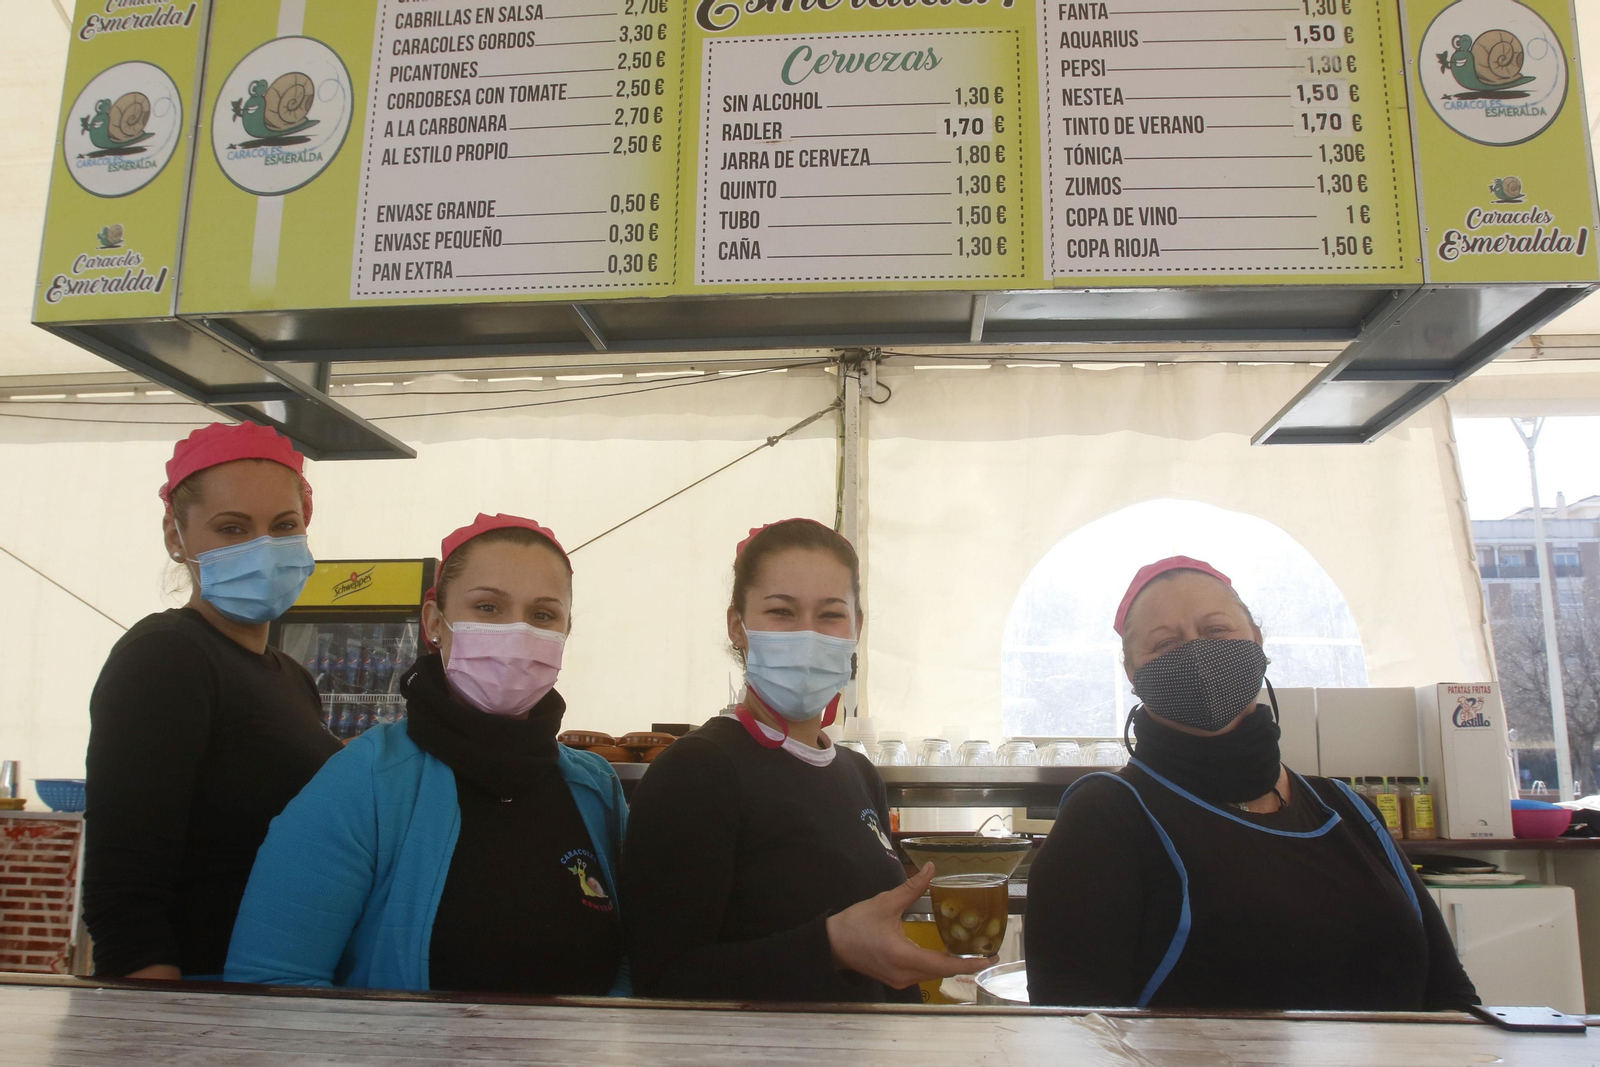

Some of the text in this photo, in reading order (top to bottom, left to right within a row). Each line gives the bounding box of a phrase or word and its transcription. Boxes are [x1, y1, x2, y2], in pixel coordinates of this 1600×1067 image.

[395, 9, 472, 29] CABRILLAS
[476, 7, 494, 24] EN
[498, 4, 543, 22] SALSA
[1059, 0, 1351, 20] FANTA 1,30 €
[393, 24, 667, 56] CARACOLES GORDOS 3,30 €
[1060, 25, 1354, 49] AQUARIUS 1,50 €
[390, 51, 665, 82] PICANTONES 2,50 €
[781, 45, 942, 85] Cervezas
[1061, 55, 1357, 77] PEPSI 1,30 €
[387, 78, 664, 110] CORDOBESA CON TOMATE 2,50 €
[723, 86, 1004, 112] SIN ALCOHOL 1,30 €
[1062, 84, 1359, 106] NESTEA 1,50 €
[1443, 99, 1501, 110] CARACOLES
[384, 106, 663, 137] A LA CARBONARA 2,70 €
[1485, 104, 1547, 117] ESMERALDA
[722, 115, 1004, 141] RADLER 1,70 €
[1063, 113, 1362, 135] TINTO DE VERANO 1,70 €
[76, 155, 123, 168] CARACOLES
[226, 147, 282, 160] CARACOLES
[264, 148, 323, 166] ESMERALDA
[382, 135, 662, 165] AL ESTILO PROPIO 2,50 €
[721, 145, 1005, 170] JARRA DE CERVEZA 1,80 €
[1064, 144, 1123, 165] TÓNICA
[107, 159, 157, 172] ESMERALDA
[720, 175, 1006, 200] QUINTO 1,30 €
[1065, 174, 1368, 196] ZUMOS 1,30 €
[377, 193, 659, 222] ENVASE GRANDE 0,50 €
[719, 205, 1006, 229] TUBO 1,50 €
[1066, 205, 1370, 227] COPA DE VINO 1 €
[1466, 206, 1553, 230] Caracoles
[375, 223, 658, 252] ENVASE PEQUEÑO 0,30 €
[719, 236, 1007, 260] CAÑA 1,30 €
[1067, 236, 1373, 258] COPA RIOJA 1,50 €
[73, 250, 142, 274] Caracoles
[373, 253, 657, 281] PAN EXTRA 0,30 €
[334, 574, 372, 597] Schweppes
[1447, 685, 1491, 694] PATATAS FRITAS
[1452, 697, 1490, 728] Castillo
